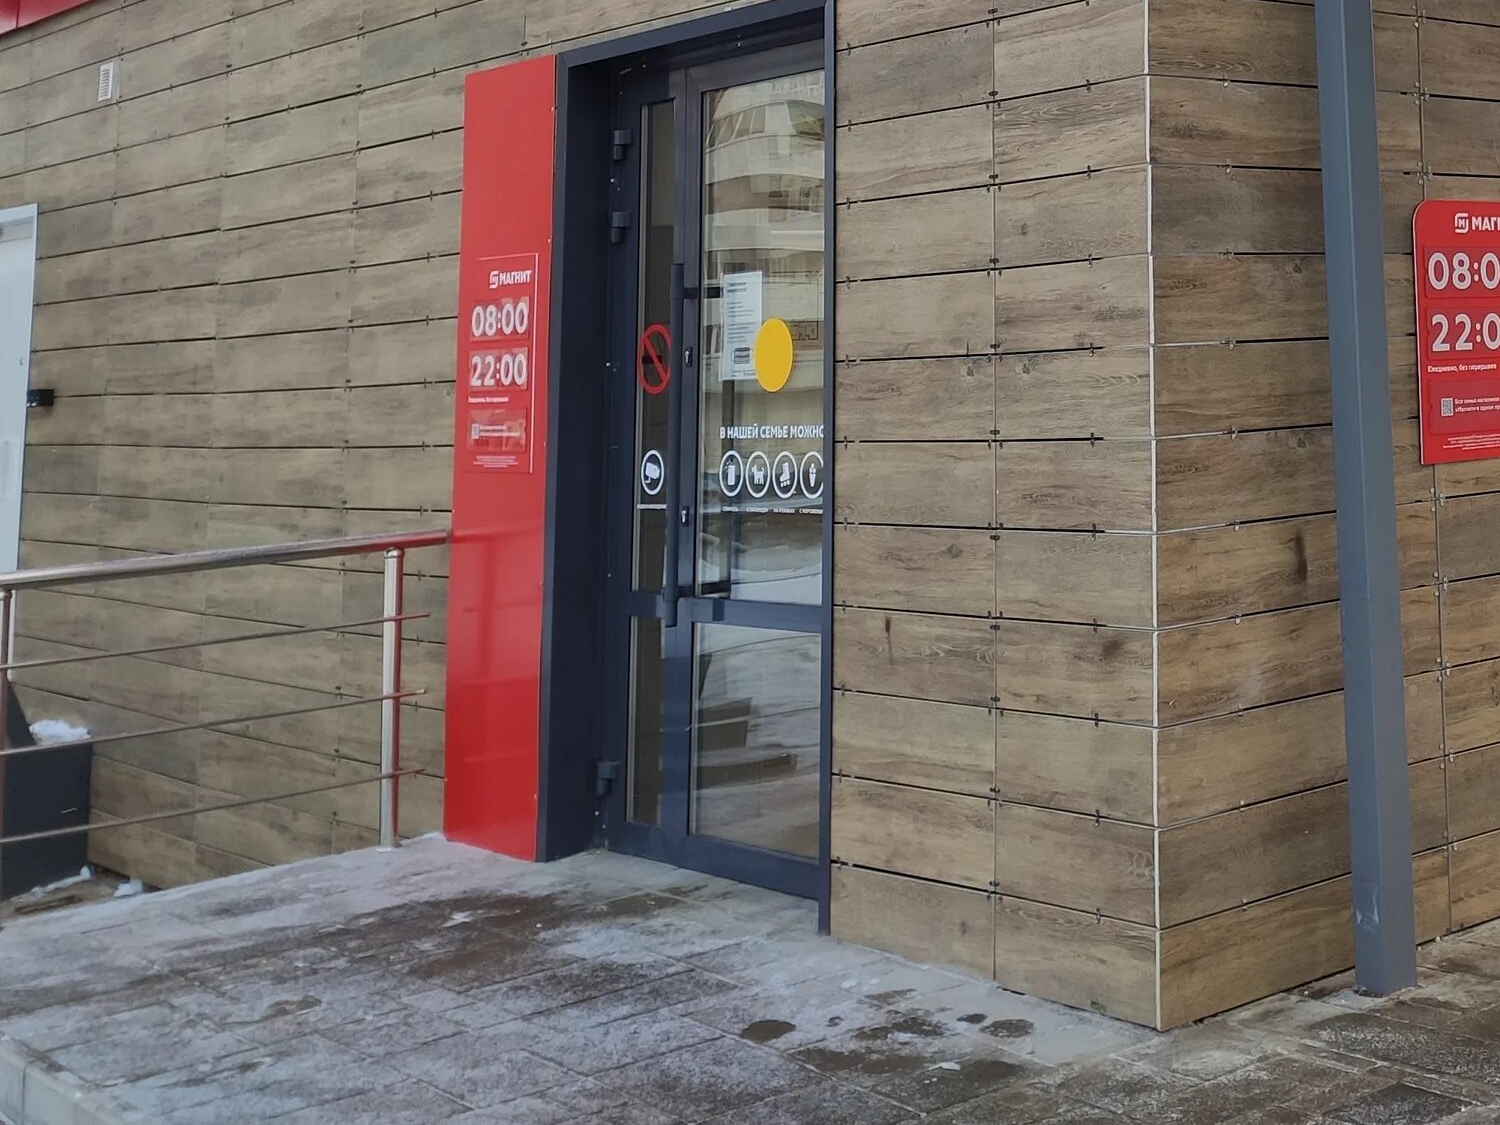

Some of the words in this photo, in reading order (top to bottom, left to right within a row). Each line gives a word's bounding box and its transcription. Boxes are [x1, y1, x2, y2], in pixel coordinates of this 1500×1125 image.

[500, 270, 532, 286] МАГНИТ
[471, 302, 528, 337] 08:00
[471, 353, 527, 386] 22:00
[720, 426, 726, 439] В
[727, 423, 758, 439] НАШЕЙ
[760, 425, 788, 438] СЕМЬЕ
